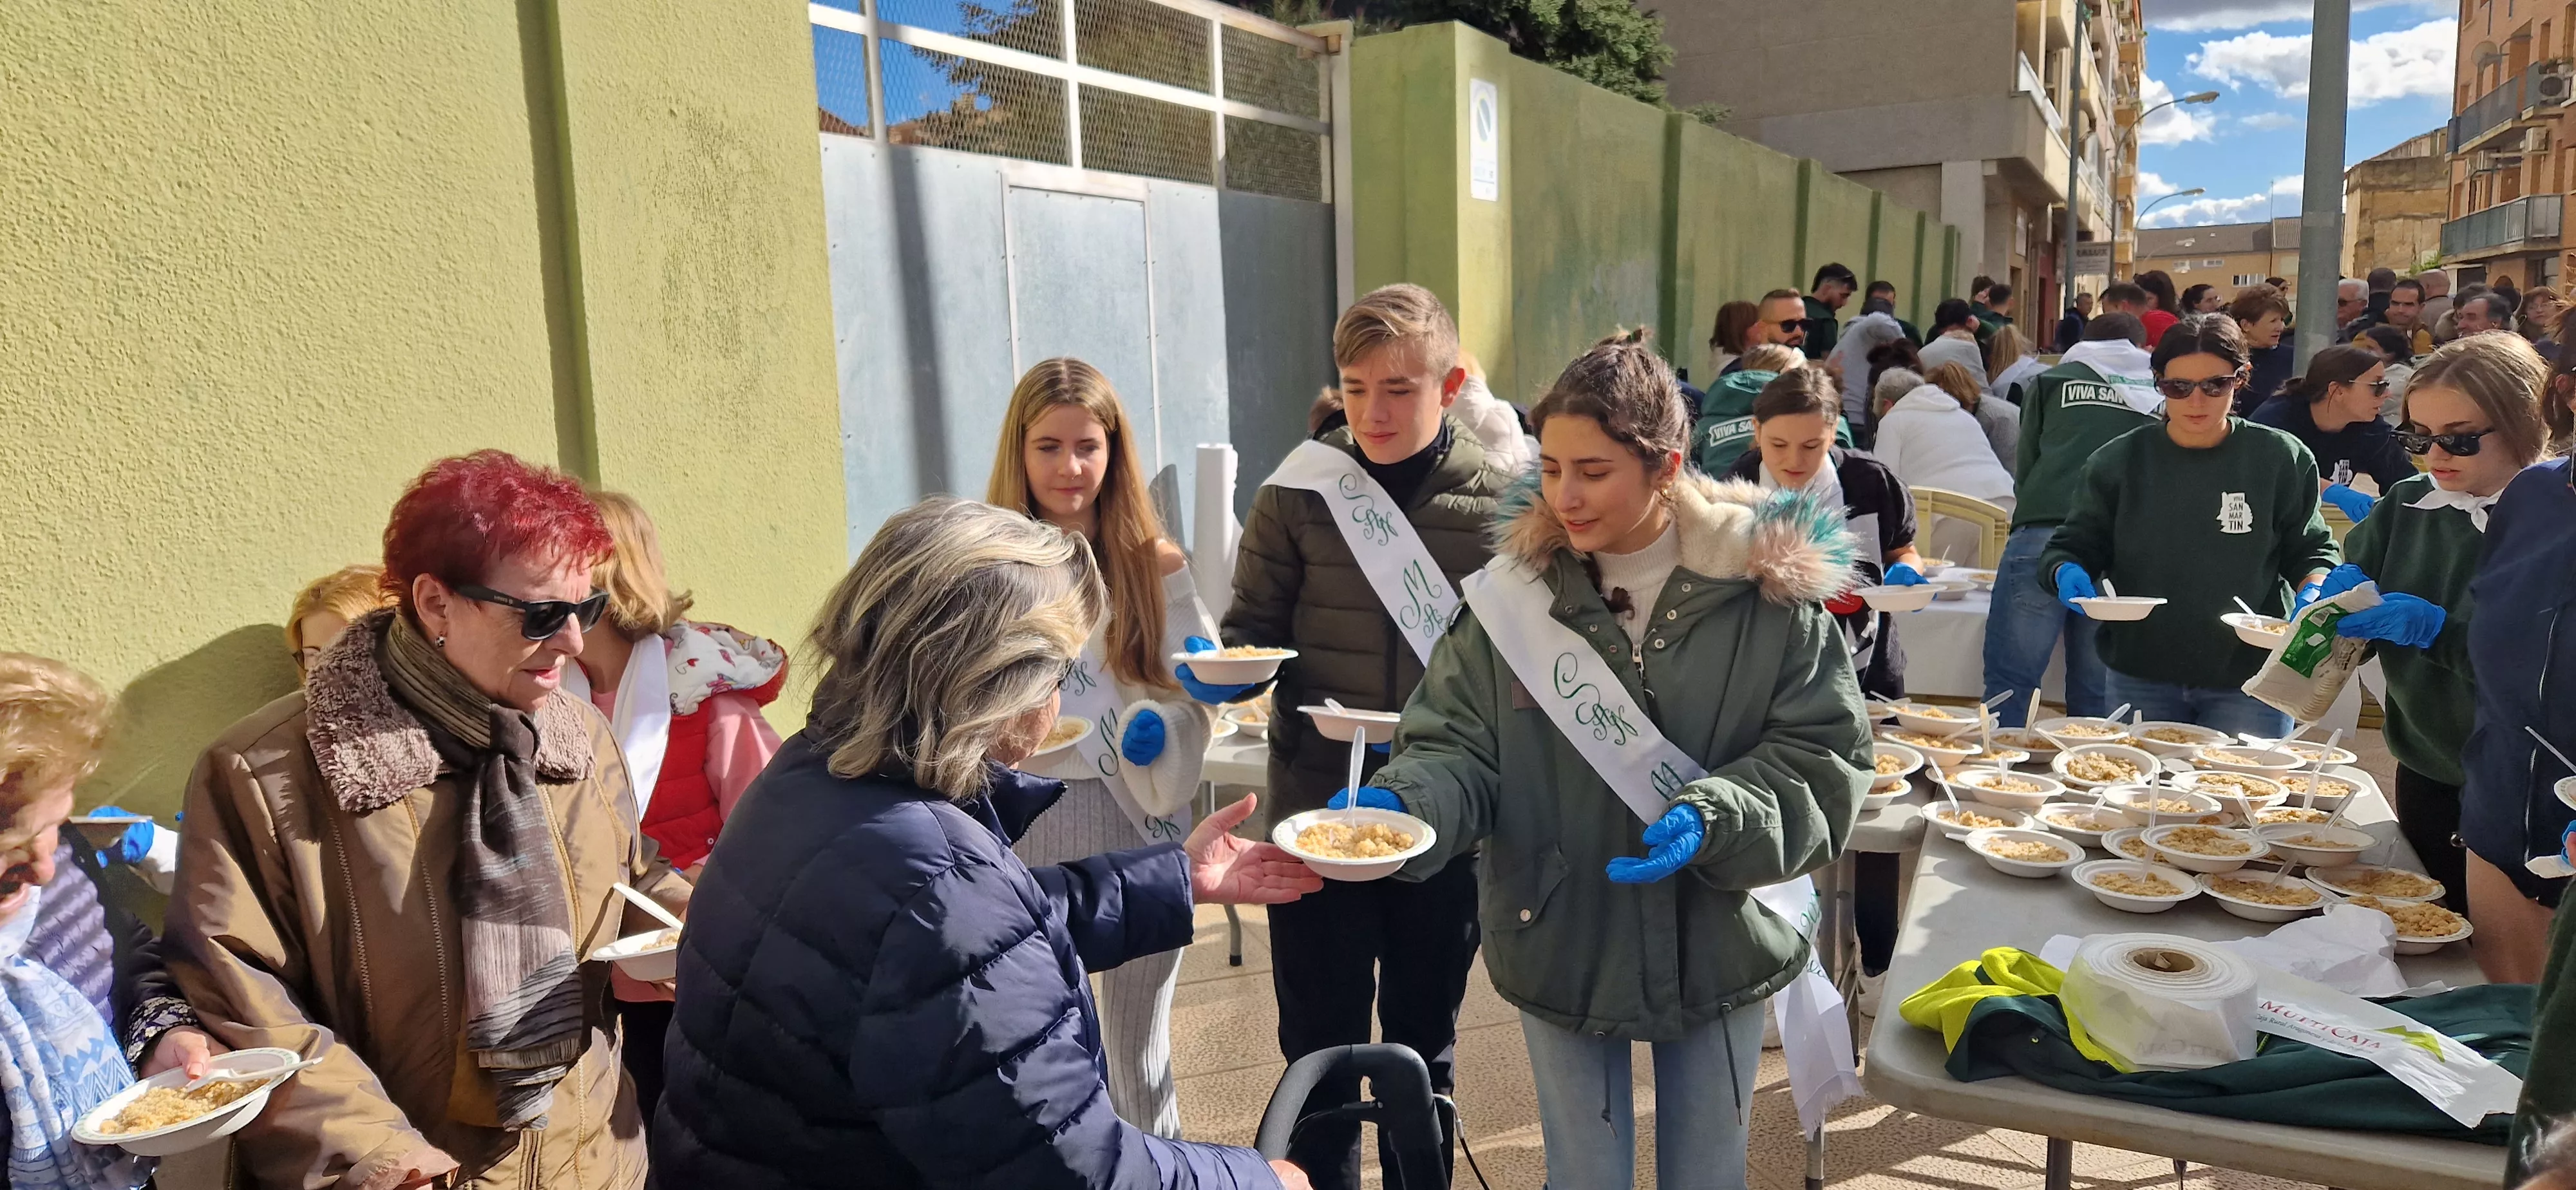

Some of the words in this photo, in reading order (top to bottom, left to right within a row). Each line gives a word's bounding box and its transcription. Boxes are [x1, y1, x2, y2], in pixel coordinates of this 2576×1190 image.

[2067, 384, 2096, 401] VIVA
[2098, 386, 2126, 404] SAN
[1714, 423, 1737, 439] VIVA
[2228, 502, 2244, 511] SAN
[2228, 520, 2244, 531] TIN
[2269, 1017, 2287, 1027] Rural
